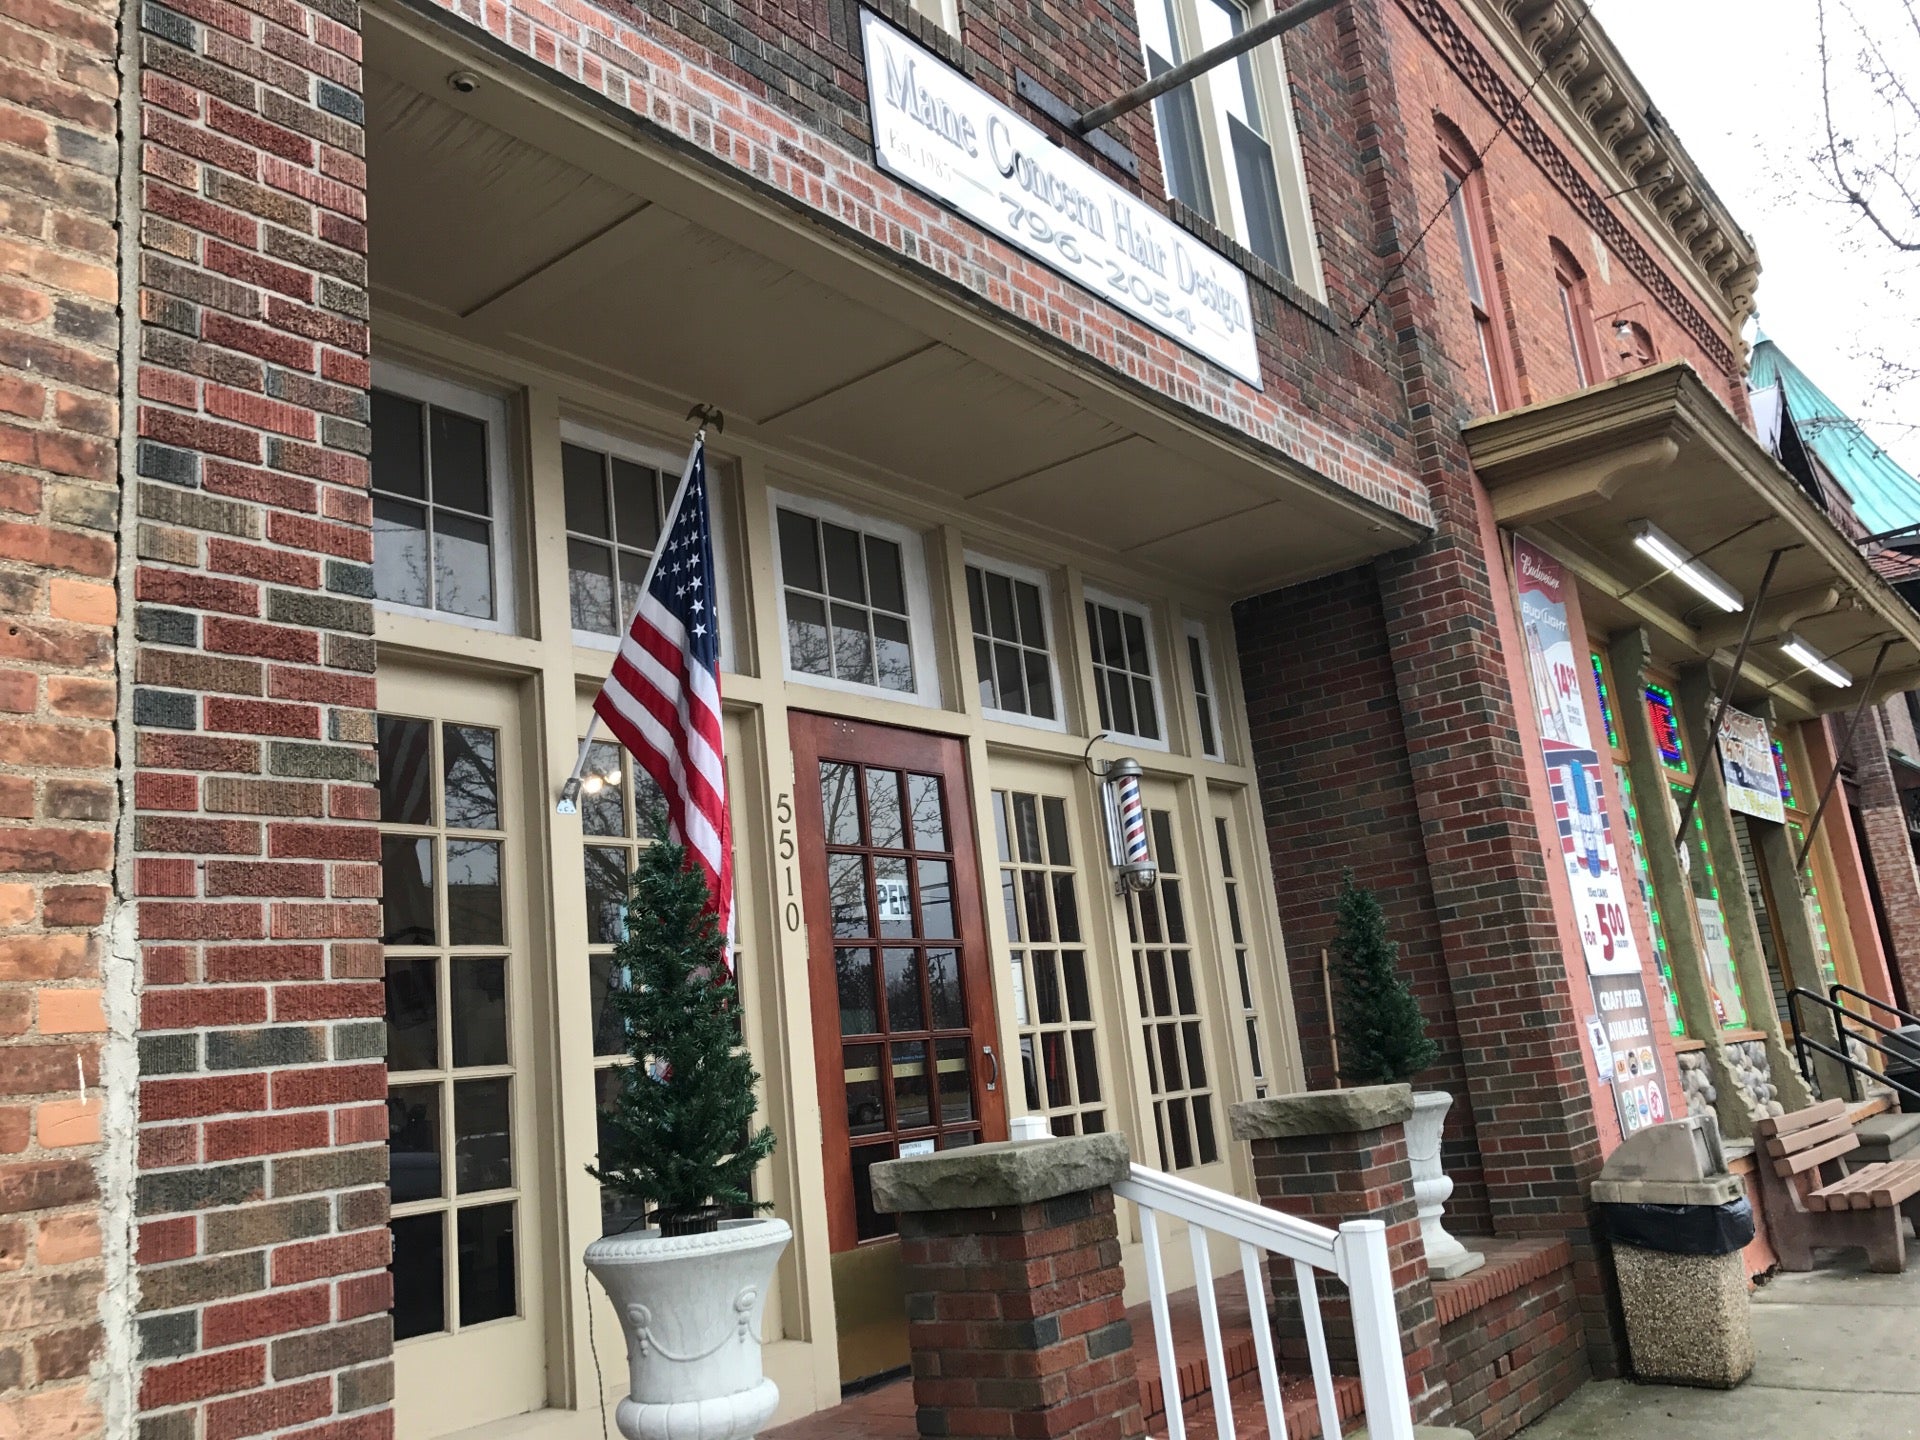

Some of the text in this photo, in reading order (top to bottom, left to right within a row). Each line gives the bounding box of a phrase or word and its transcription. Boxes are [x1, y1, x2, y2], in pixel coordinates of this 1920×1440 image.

[877, 34, 1248, 334] Mane Concern Hair Design
[1000, 192, 1196, 336] 796-2054
[1520, 553, 1560, 589] Budweiser
[1523, 602, 1567, 632] BUD LIGHT
[777, 793, 800, 932] 5510
[875, 884, 911, 914] PEN
[1584, 931, 1597, 946] FOR
[1600, 988, 1643, 1011] CRAFT BEER
[1608, 1017, 1649, 1041] AVAILABLE
